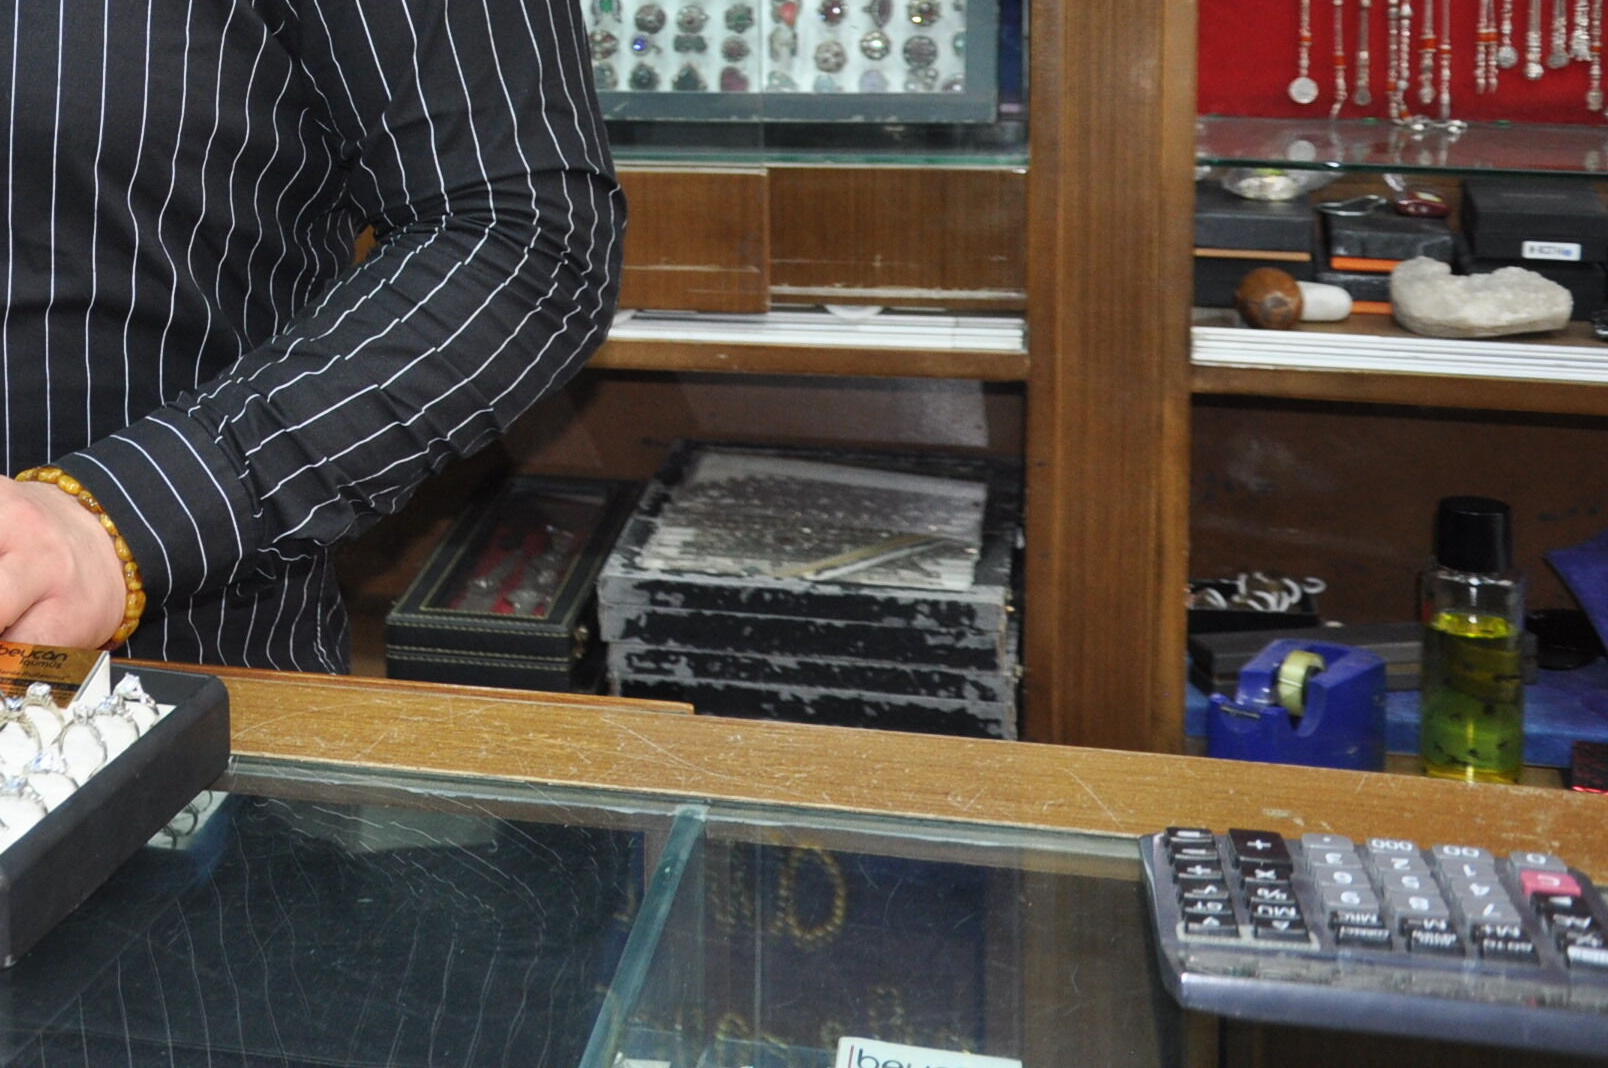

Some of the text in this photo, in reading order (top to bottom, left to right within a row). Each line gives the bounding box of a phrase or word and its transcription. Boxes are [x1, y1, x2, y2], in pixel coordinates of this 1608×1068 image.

[1372, 838, 1412, 852] 000
[1443, 845, 1480, 858] 00
[1391, 858, 1411, 870] 2
[1526, 853, 1546, 865] 0
[1470, 883, 1490, 897] 4
